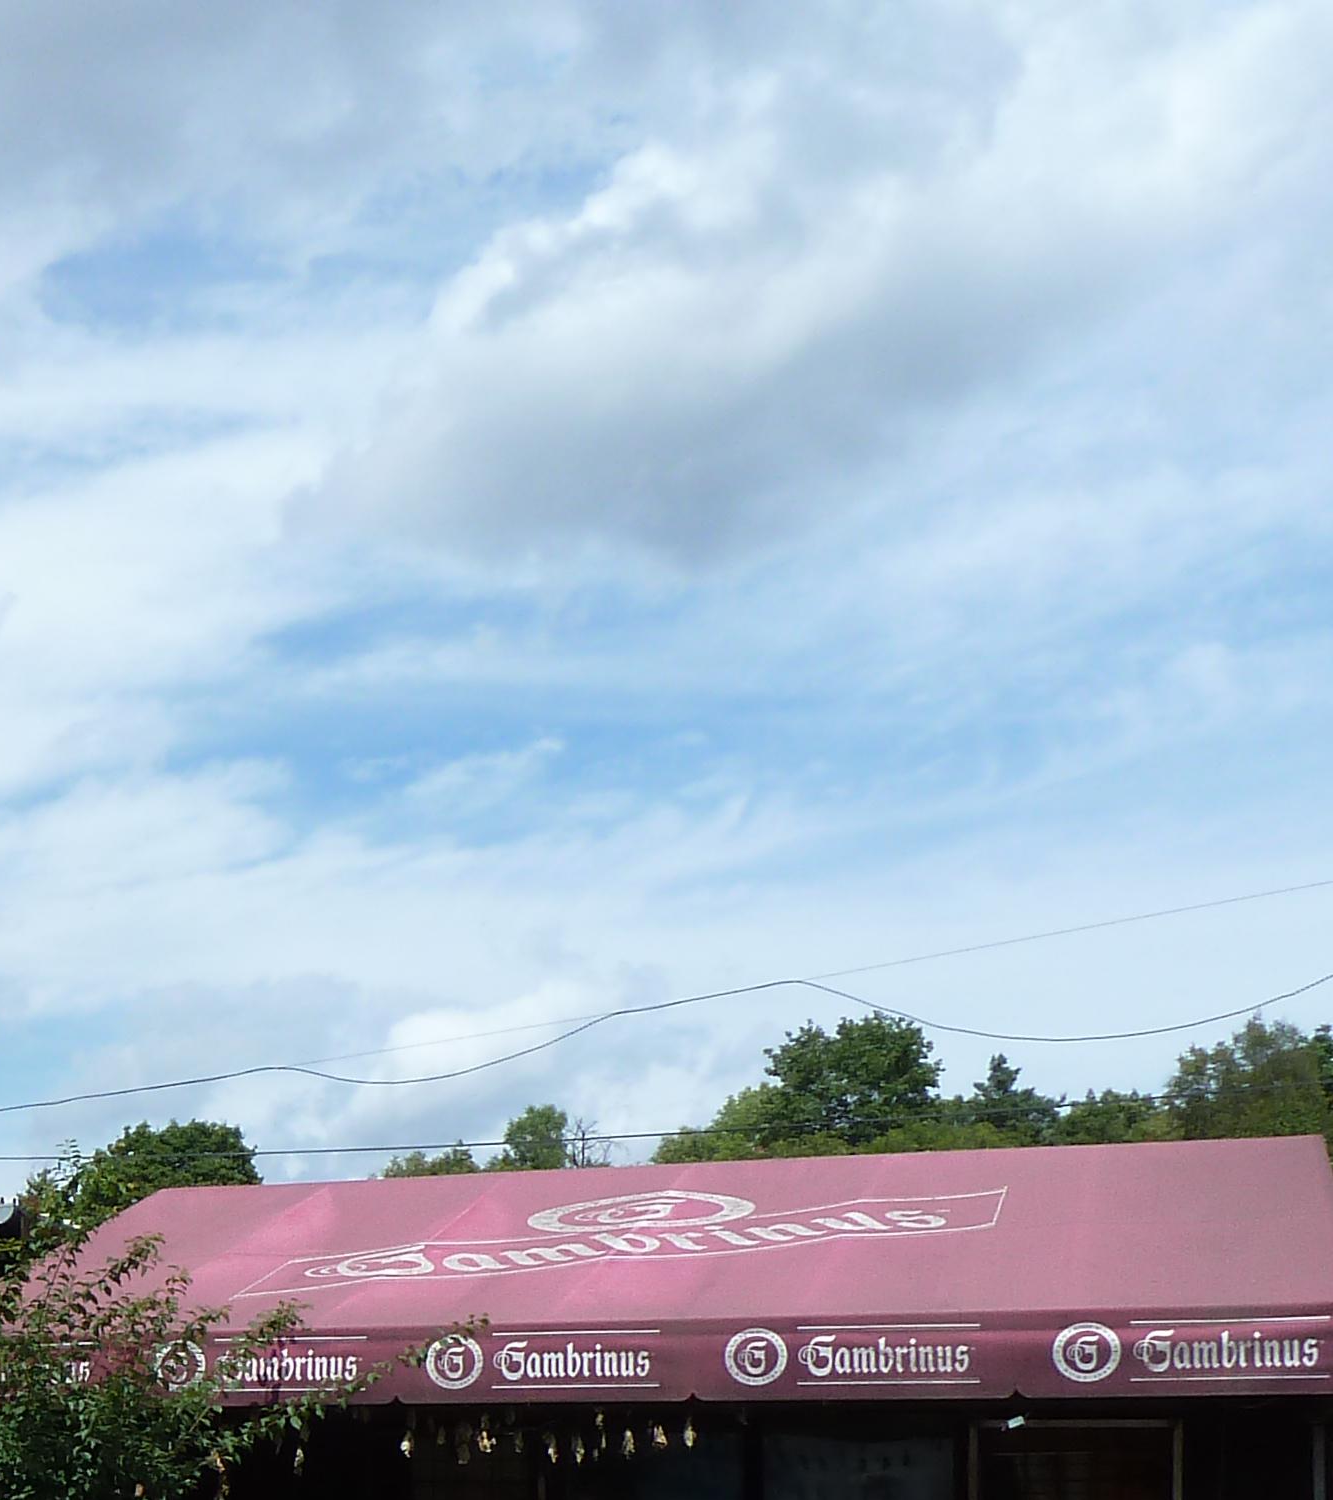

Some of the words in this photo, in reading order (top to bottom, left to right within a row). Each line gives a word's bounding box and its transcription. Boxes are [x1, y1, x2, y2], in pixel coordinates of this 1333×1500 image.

[304, 1207, 946, 1277] Gambrinus
[493, 1341, 651, 1381] Gambrinus
[798, 1335, 970, 1376] Gambrinus
[1134, 1330, 1320, 1372] Gambrinus
